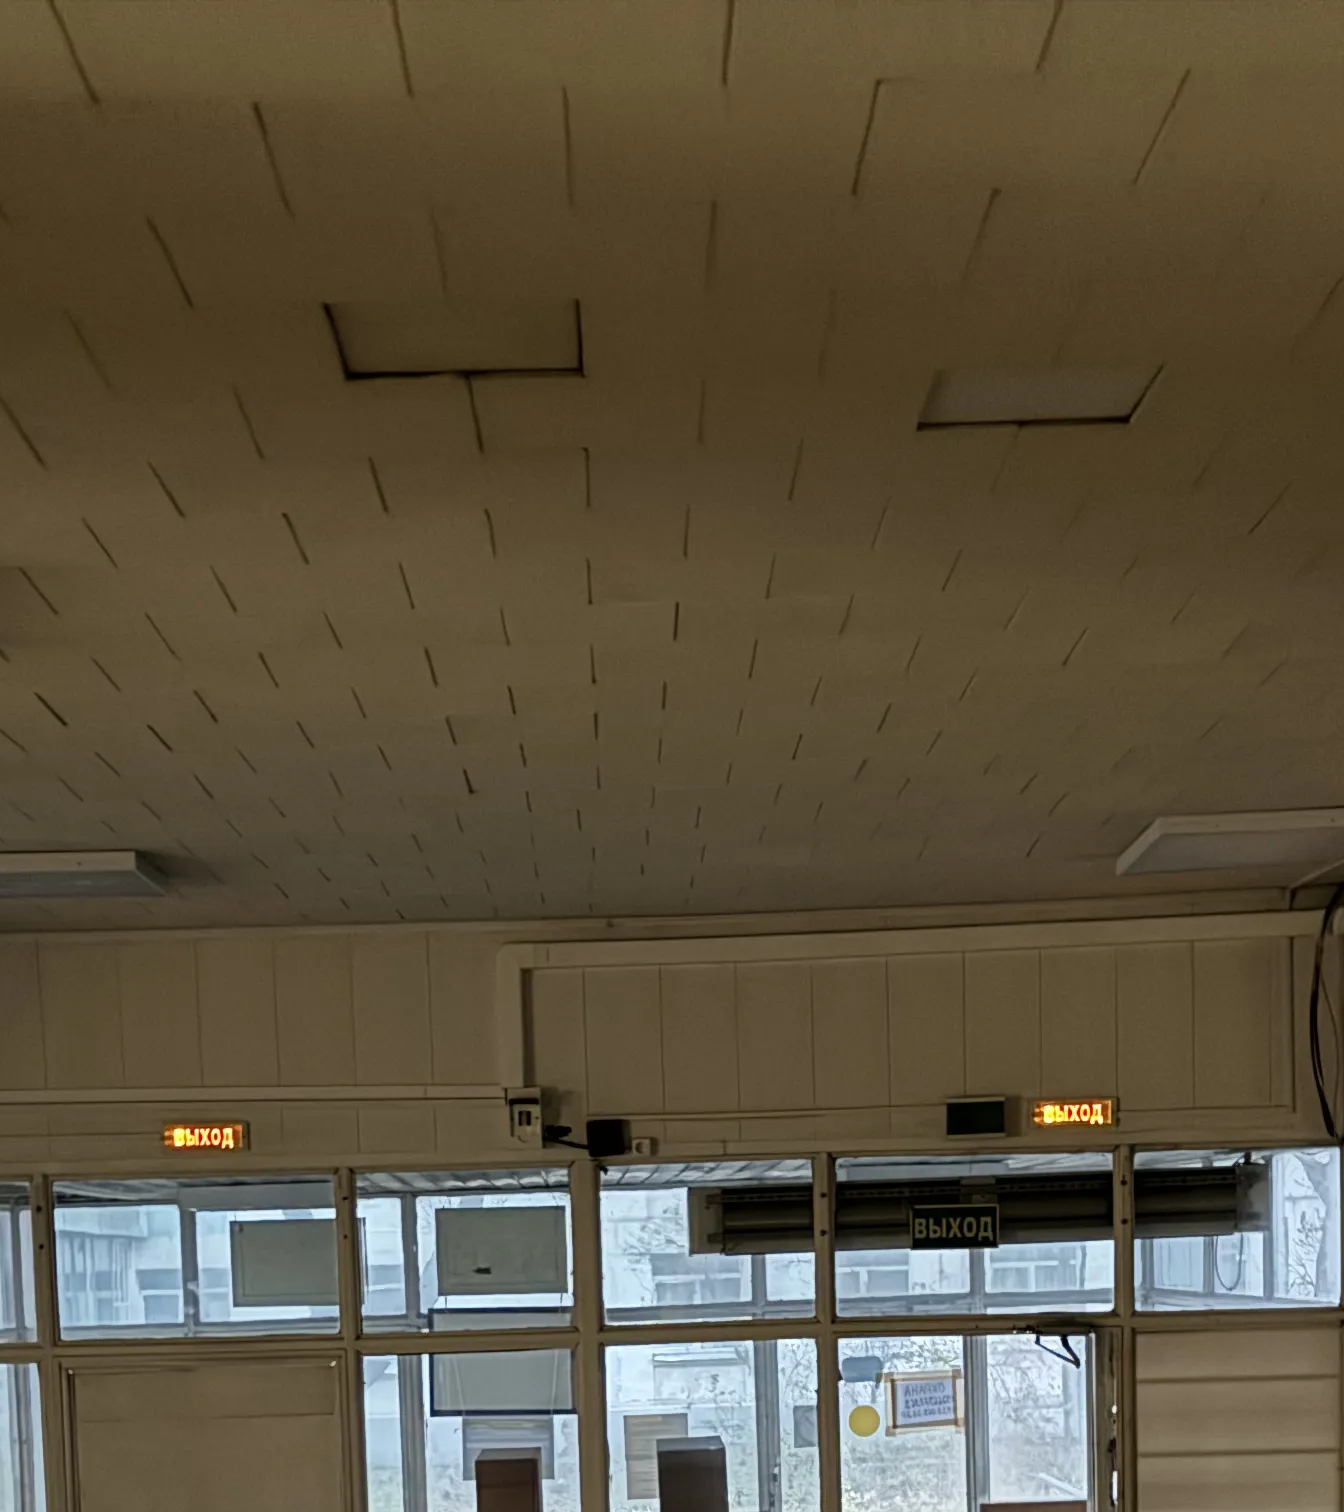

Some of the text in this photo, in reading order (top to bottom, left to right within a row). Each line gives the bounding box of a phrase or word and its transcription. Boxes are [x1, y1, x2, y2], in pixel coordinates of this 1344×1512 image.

[1043, 1103, 1104, 1125] ВЫХОД
[173, 1127, 234, 1149] ВЫХОД
[914, 1216, 993, 1242] ВЫХОД
